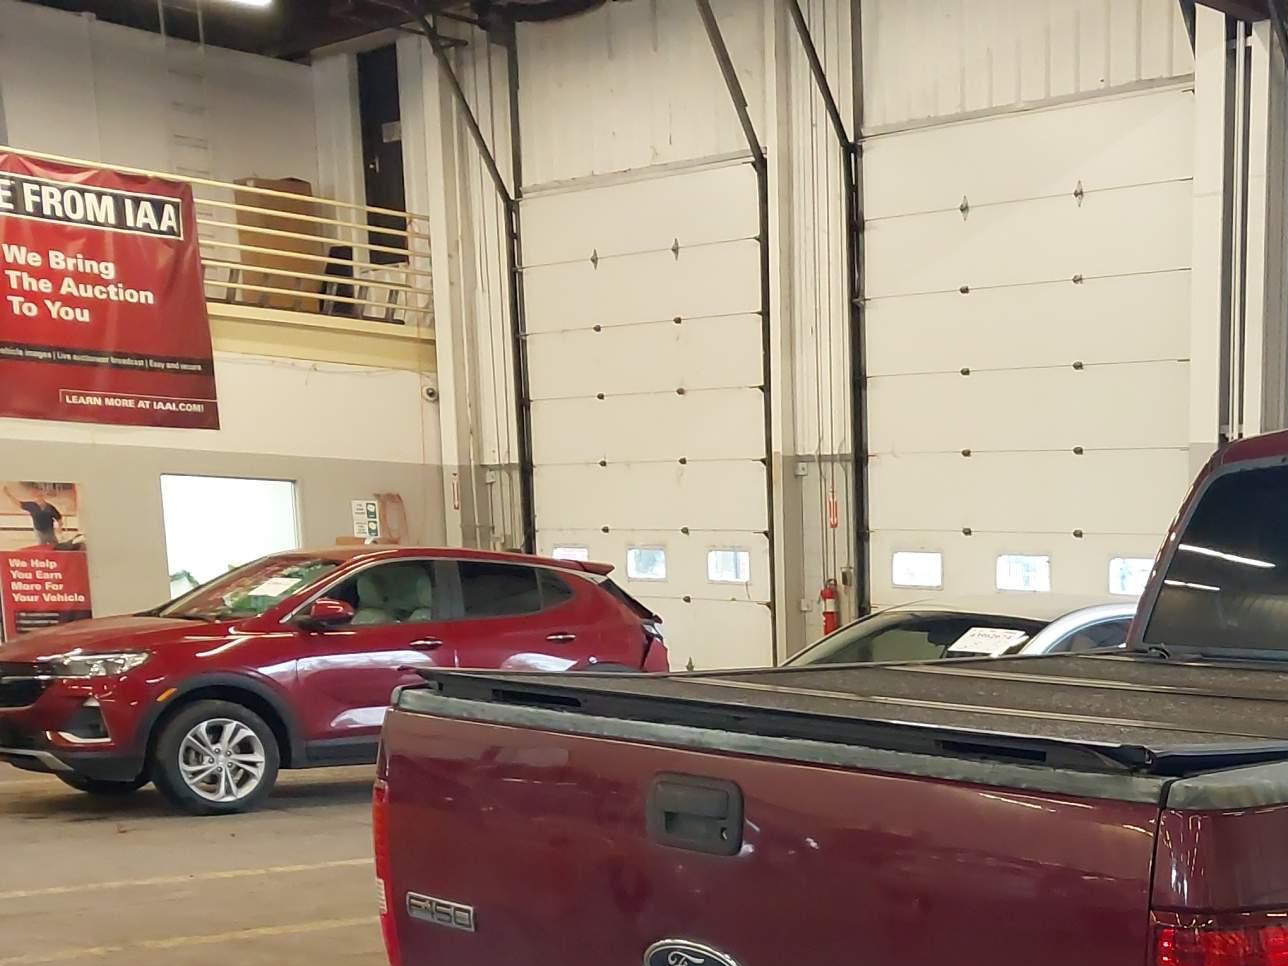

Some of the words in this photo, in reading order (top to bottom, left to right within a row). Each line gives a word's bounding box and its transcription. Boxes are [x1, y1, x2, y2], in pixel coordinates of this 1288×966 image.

[22, 182, 116, 225] FROM
[124, 198, 178, 232] IAA
[2, 243, 42, 266] We
[48, 250, 116, 280] Bring
[5, 270, 52, 293] The
[60, 277, 154, 304] Auction
[7, 295, 38, 317] To
[44, 299, 90, 322] You
[65, 394, 102, 406] LEARN
[104, 397, 136, 408] MORE
[137, 399, 151, 409] AT
[8, 558, 28, 568] We
[30, 559, 58, 570] Help
[10, 570, 33, 580] You
[35, 570, 63, 580] Earn
[11, 582, 42, 591] More
[44, 582, 64, 591] For
[12, 592, 40, 602] Your
[42, 593, 86, 603] Vehicle
